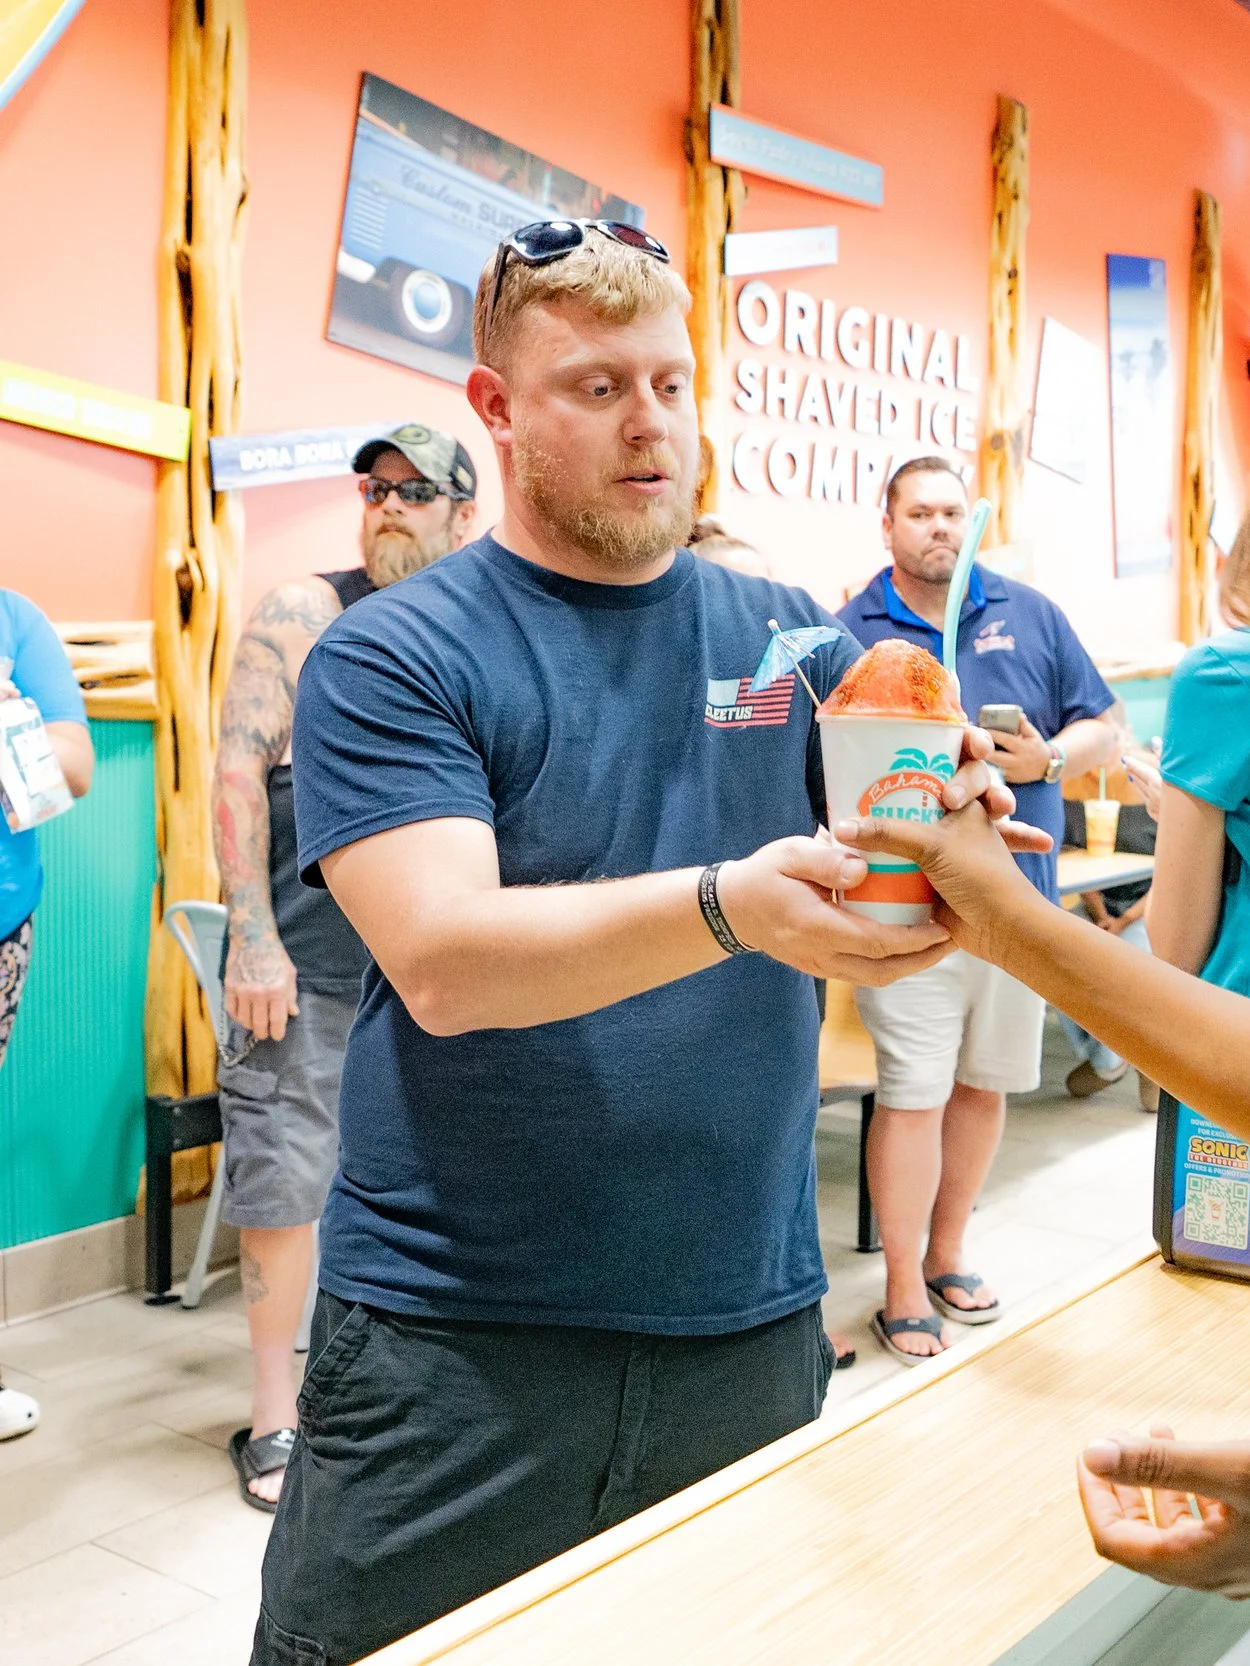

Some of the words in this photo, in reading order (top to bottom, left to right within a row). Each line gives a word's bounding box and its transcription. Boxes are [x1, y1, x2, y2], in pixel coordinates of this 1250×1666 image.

[736, 280, 979, 393] ORIGINAL
[734, 357, 902, 437] SHAVED
[914, 394, 977, 451] ICE
[240, 446, 293, 472] BORA
[732, 431, 975, 509] COMP
[705, 704, 753, 722] CLEETUS
[1191, 1137, 1249, 1161] SONIC
[1184, 1162, 1206, 1171] OFFERS
